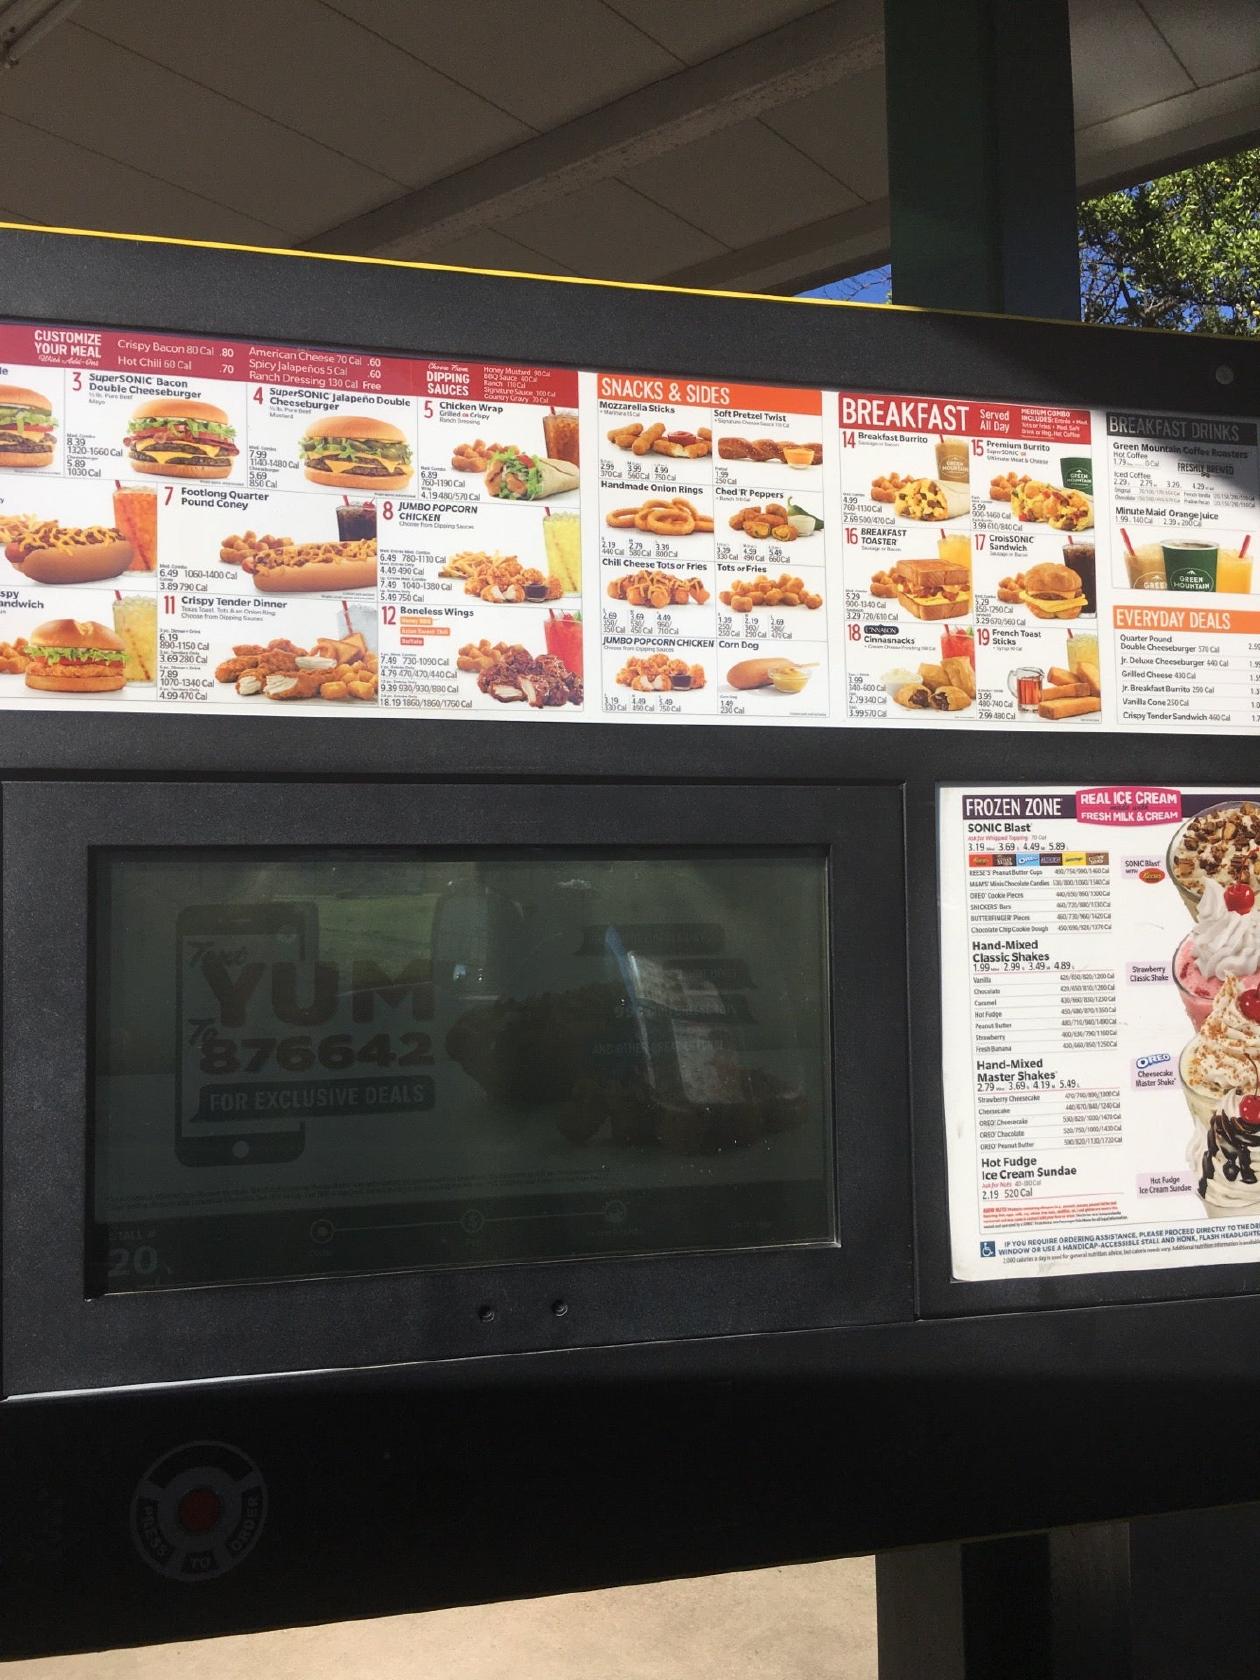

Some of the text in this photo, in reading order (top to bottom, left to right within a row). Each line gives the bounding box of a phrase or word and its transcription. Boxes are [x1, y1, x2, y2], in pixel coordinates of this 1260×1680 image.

[35, 330, 101, 345] CUSTOMIZE
[35, 342, 101, 358] YOUR MEAL
[118, 340, 234, 357] Crispy Bacon 80 Cal .80
[249, 347, 381, 367] American Cheese 70 Cal .60
[118, 356, 234, 374] Hot Chili 60 Cal .70
[250, 360, 276, 372] Spicy
[278, 363, 325, 374] Jalapeños
[334, 368, 347, 376] Cal
[368, 370, 381, 378] .60
[72, 372, 82, 391] 3
[89, 373, 188, 388] SuperSONIC Bacon
[250, 371, 382, 390] Ranch Dressing 130 Cal Free
[427, 371, 470, 384] DIPPING
[89, 383, 202, 399] Double Cheeseburger
[253, 387, 263, 404] 4
[428, 383, 469, 396] SAUCES
[602, 378, 730, 404] SNACKS & SIDES
[270, 397, 339, 411] Cheeseburger
[424, 400, 433, 418] 5
[439, 401, 503, 416] Chicken Wrap
[600, 401, 675, 413] Mozzarella Sticks
[714, 410, 786, 422] Soft Pretzel Twist
[843, 398, 969, 430] BREAKFAST
[980, 409, 1009, 421] Served
[981, 421, 992, 431] All
[994, 422, 1009, 433] Day
[1110, 416, 1240, 441] BREAKFAST DRINKS
[843, 431, 855, 448] 14
[858, 432, 928, 443] Breakfast Burrito
[972, 440, 984, 456] 15
[987, 441, 1050, 452] Premium Burrito
[181, 488, 269, 501] Footlong Quarter
[601, 481, 703, 495] Handmade Onion Rings
[165, 487, 173, 505] 7
[182, 497, 248, 510] Pound Coney
[383, 501, 393, 520] 8
[398, 502, 478, 514] JUMBO POPCORN
[400, 512, 441, 522] CHICKEN
[1116, 507, 1218, 520] Minute Maid Orange Juice
[845, 528, 857, 544] 16
[862, 528, 907, 537] BREAKFAST
[862, 537, 897, 546] TOASTER
[602, 559, 621, 567] Chili
[624, 560, 655, 568] Cheese
[657, 562, 676, 570] Tots
[687, 562, 707, 571] Fries
[717, 564, 735, 572] Tots
[746, 565, 767, 573] Fries
[165, 596, 175, 614] 11
[182, 597, 287, 609] Crispy Tender Dinner
[382, 606, 396, 625] 12
[400, 607, 474, 618] Boneless Wings
[1117, 609, 1231, 629] EVERYDAY DEALS
[848, 624, 861, 641] 18
[978, 628, 989, 645] 19
[992, 629, 1041, 638] French Toast
[1120, 634, 1148, 642] Quarter
[602, 637, 714, 648] JUMBO POPCORN CHICKEN
[719, 641, 759, 650] Corn Dog
[864, 636, 915, 645] Cinnasnacks
[1147, 644, 1196, 653] Cheeseburger
[1081, 792, 1177, 805] REAL ICE CREAM
[966, 798, 1062, 816] FROZEN ZONE
[1081, 811, 1178, 821] FRESH MILK & CREAM
[968, 822, 1031, 832] SONIC Blast
[973, 940, 1038, 950] Hand-Mixed
[973, 952, 1049, 963] Classic Shakes
[200, 959, 435, 1028] YUM
[200, 1032, 435, 1075] 876642
[977, 1059, 1043, 1070] Hand-Mixed
[977, 1071, 1056, 1082] Master Shakes
[210, 1083, 425, 1112] FOR EXCLUSIVE DEALS
[982, 1156, 1037, 1168] Hot Fudge
[982, 1166, 1077, 1180] Ice Cream Sundae
[1059, 1235, 1094, 1243] ORDERING
[1095, 1232, 1137, 1242] ASSISTANCE,
[1139, 1229, 1164, 1238] PLEASE
[1165, 1227, 1195, 1236] PROCEED
[1196, 1225, 1226, 1235] DIRECTLY
[1237, 1223, 1250, 1231] THE
